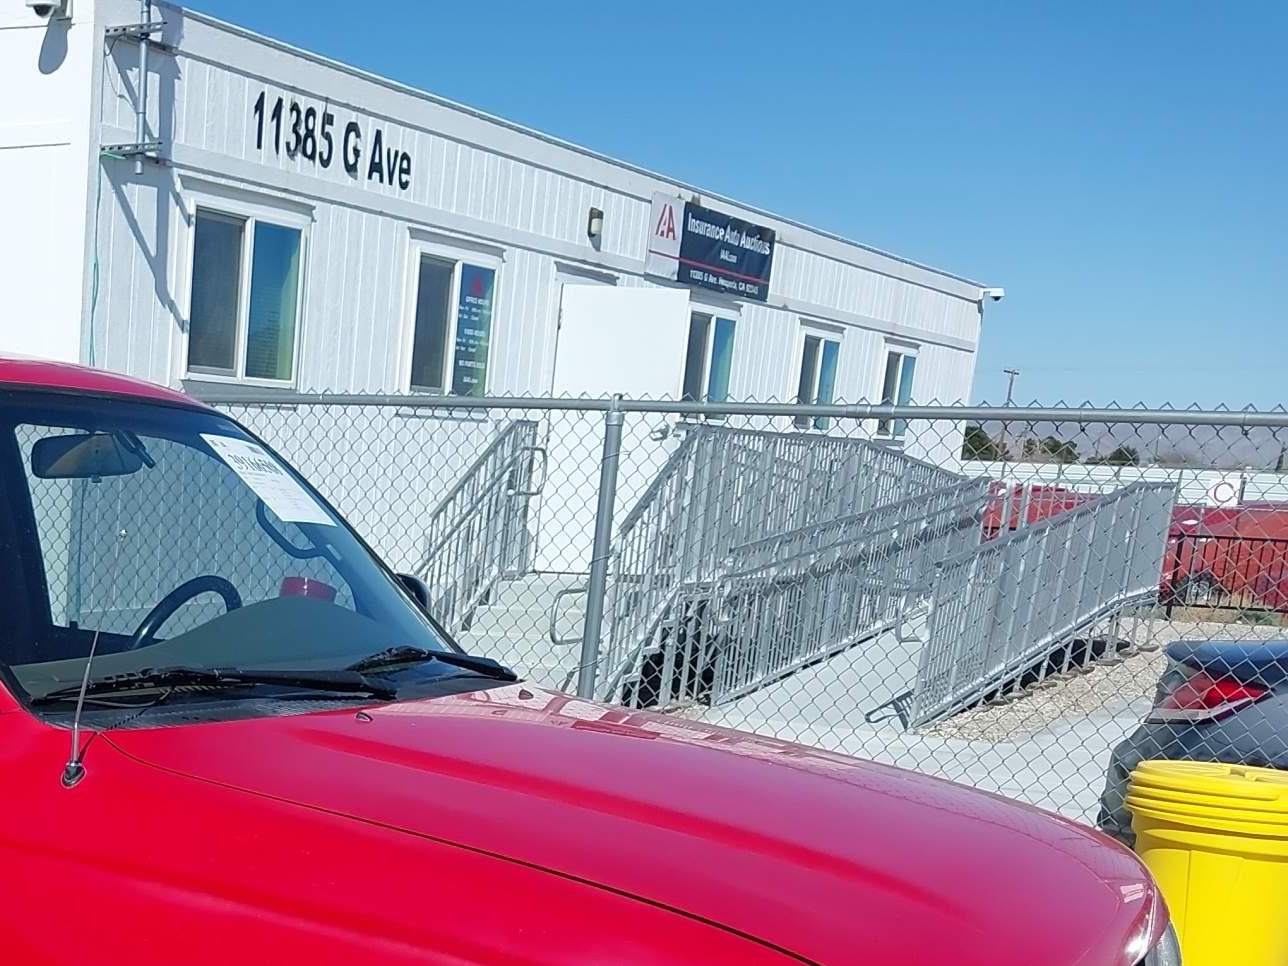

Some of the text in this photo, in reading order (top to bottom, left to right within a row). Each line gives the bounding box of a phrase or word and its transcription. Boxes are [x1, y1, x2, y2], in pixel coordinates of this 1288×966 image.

[253, 91, 412, 190] 11385 G Ave
[687, 212, 770, 255] Insurance Auto Auctions
